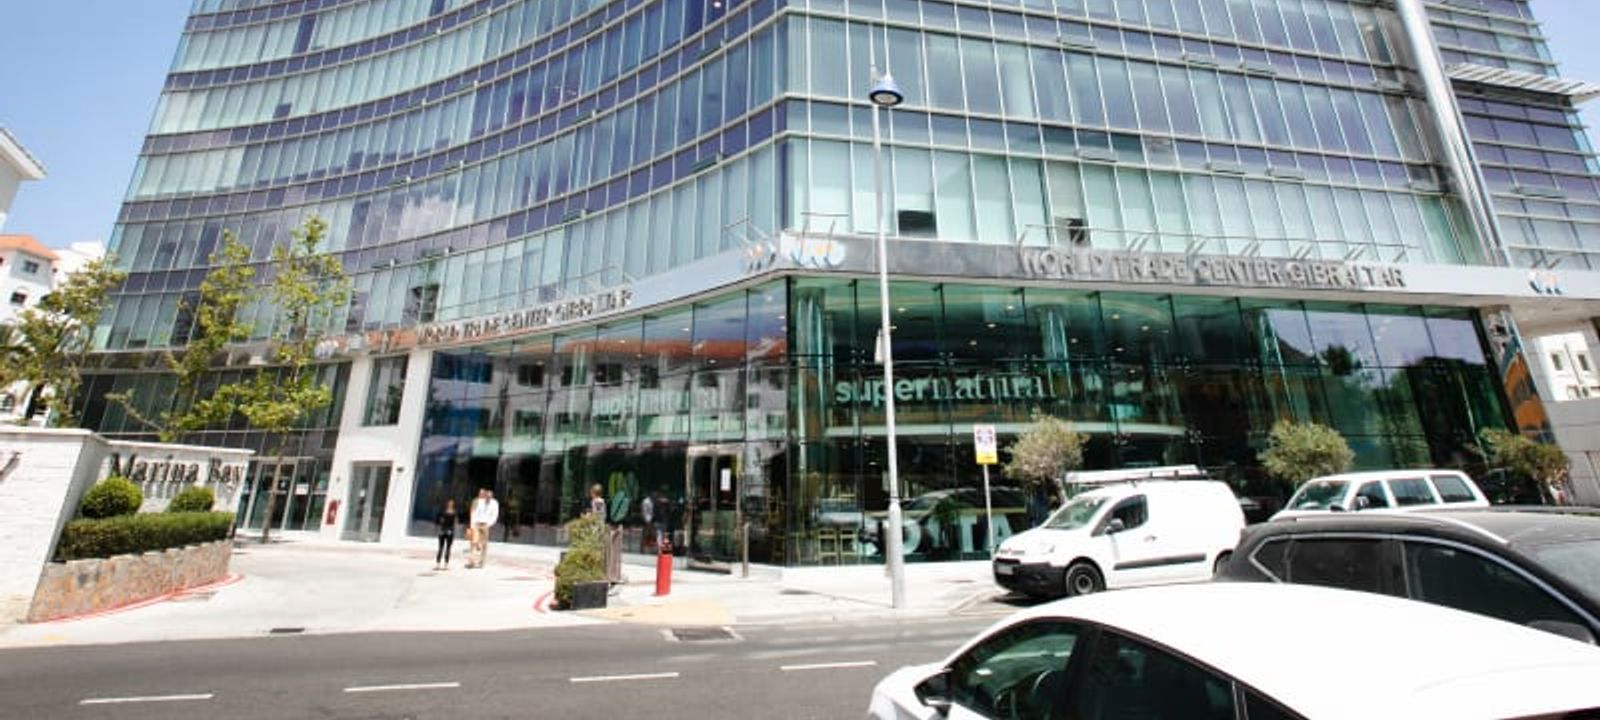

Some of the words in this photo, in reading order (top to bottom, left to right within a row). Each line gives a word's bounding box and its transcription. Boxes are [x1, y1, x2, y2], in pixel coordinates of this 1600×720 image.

[1021, 250, 1104, 278] WORLD
[1112, 255, 1185, 281] TRADE
[1195, 257, 1280, 285] CENTER
[1284, 261, 1407, 289] GIBRALTAR
[835, 374, 1057, 407] supernatural
[108, 452, 200, 482] Marina
[207, 456, 245, 489] Bay
